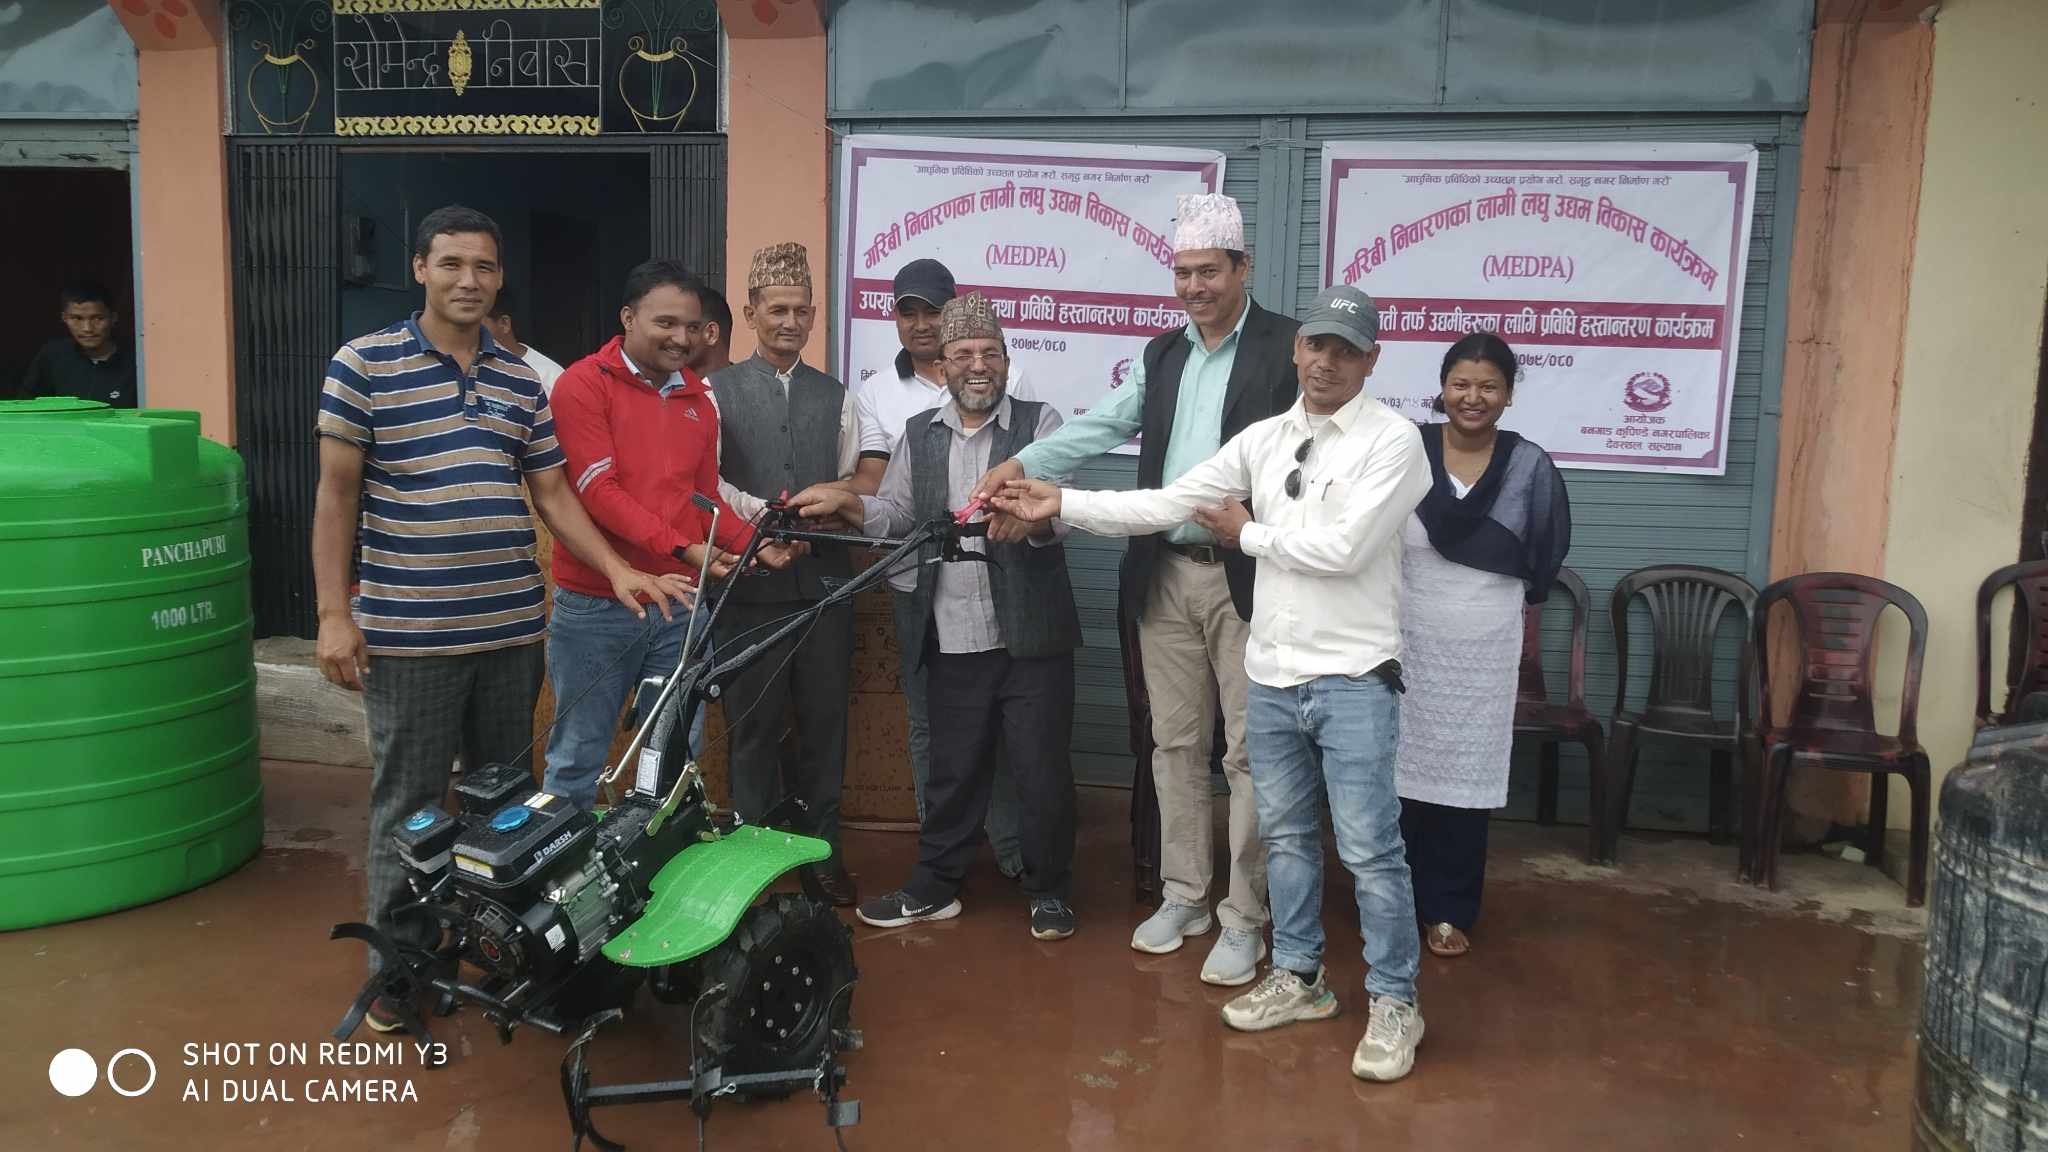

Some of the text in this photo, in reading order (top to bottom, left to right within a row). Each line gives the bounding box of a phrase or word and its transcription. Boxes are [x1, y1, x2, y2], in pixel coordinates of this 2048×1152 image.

[864, 222, 902, 269] गरिबी
[904, 192, 976, 241] निवारणका
[980, 181, 1015, 212] लागी
[1019, 186, 1046, 215] लघु
[1085, 191, 1131, 237] विकास
[1342, 236, 1386, 286] गरिबी
[1390, 200, 1472, 256] निवारणका
[1476, 187, 1517, 222] लागी
[1521, 193, 1551, 223] लघु
[1596, 196, 1648, 243] विकास
[1650, 226, 1719, 291] कार्यक्रम
[986, 243, 1066, 273] (MEDPA)
[1482, 254, 1574, 284] (MEDPA)
[991, 298, 1017, 319] तथा
[1020, 295, 1056, 322] प्रविधि
[1059, 302, 1129, 327] हस्तान्तरण
[1330, 297, 1360, 314] UFC
[1401, 306, 1426, 332] तर्फ
[1504, 306, 1538, 334] लागि
[1540, 307, 1578, 337] प्रविधि
[1580, 315, 1652, 338] हस्तान्तरण
[1654, 312, 1715, 339] कार्यक्रम
[1623, 413, 1666, 425] आयोजक
[141, 534, 226, 568] PANCHAPURI
[151, 606, 186, 630] 1000
[541, 830, 572, 856] DARSH
